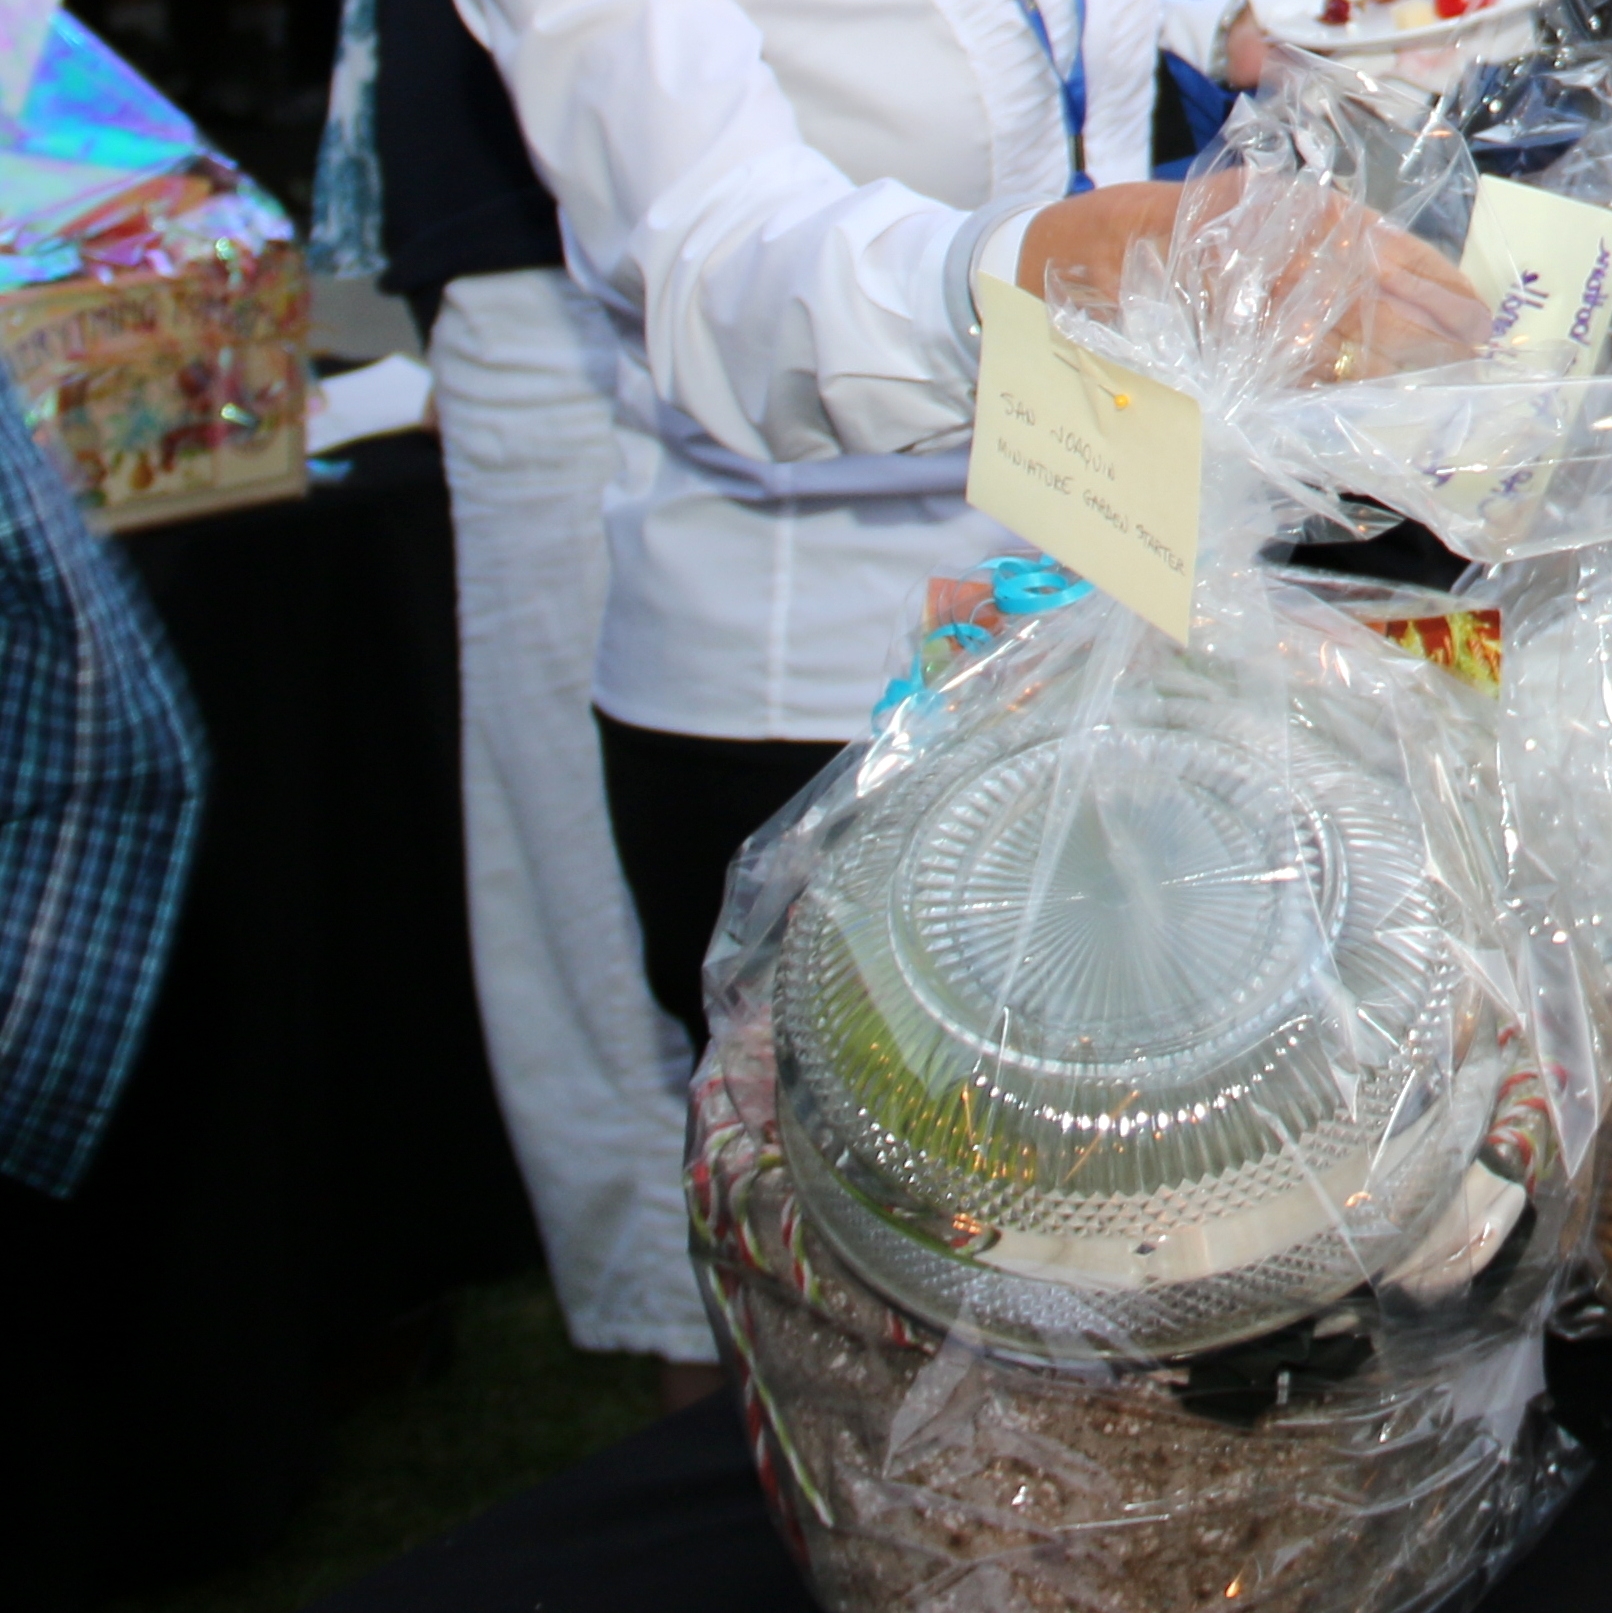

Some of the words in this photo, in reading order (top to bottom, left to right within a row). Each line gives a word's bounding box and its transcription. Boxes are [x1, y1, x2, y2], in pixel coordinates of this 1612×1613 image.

[1000, 391, 1036, 427] SAN
[1050, 425, 1116, 481] JOAQUIN
[996, 437, 1074, 496] MINIATURE
[1082, 489, 1129, 535] GARDEN
[1135, 523, 1186, 576] STARTER
